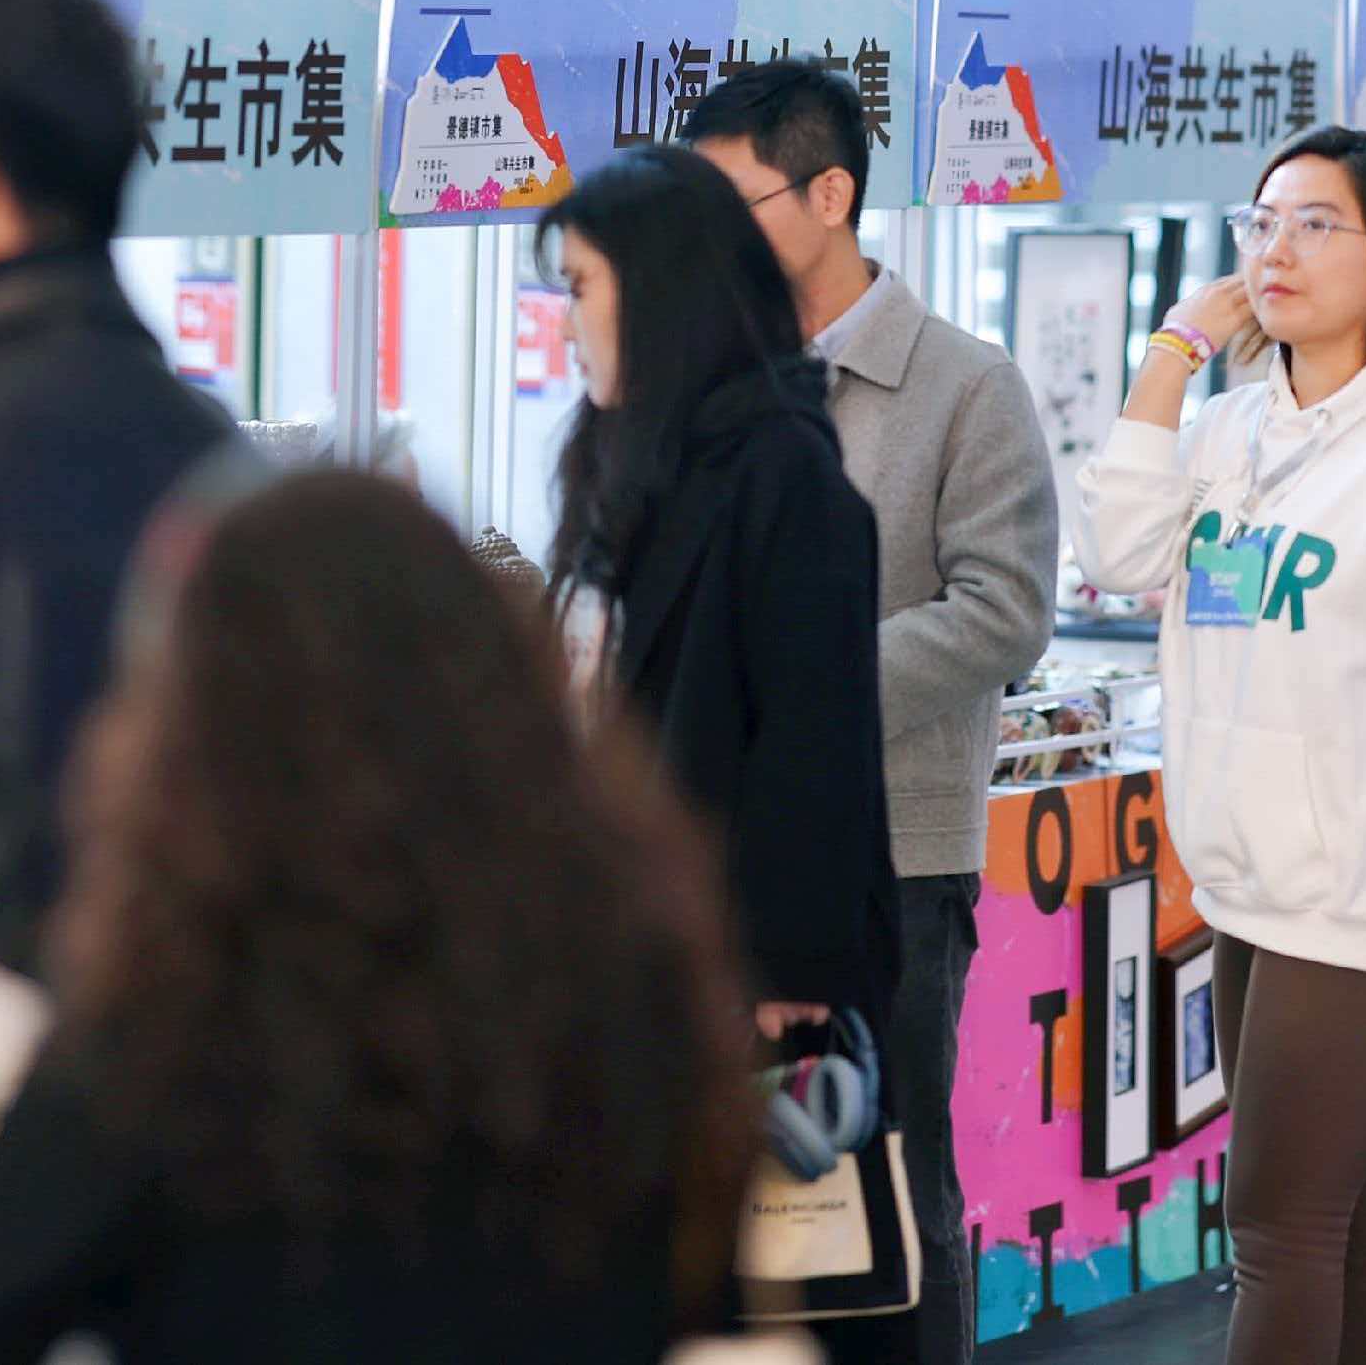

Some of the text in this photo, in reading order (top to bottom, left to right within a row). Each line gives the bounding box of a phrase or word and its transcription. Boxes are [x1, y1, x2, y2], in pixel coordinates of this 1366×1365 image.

[614, 37, 891, 149] 山海集
[1098, 44, 1316, 149] 山海共生市集
